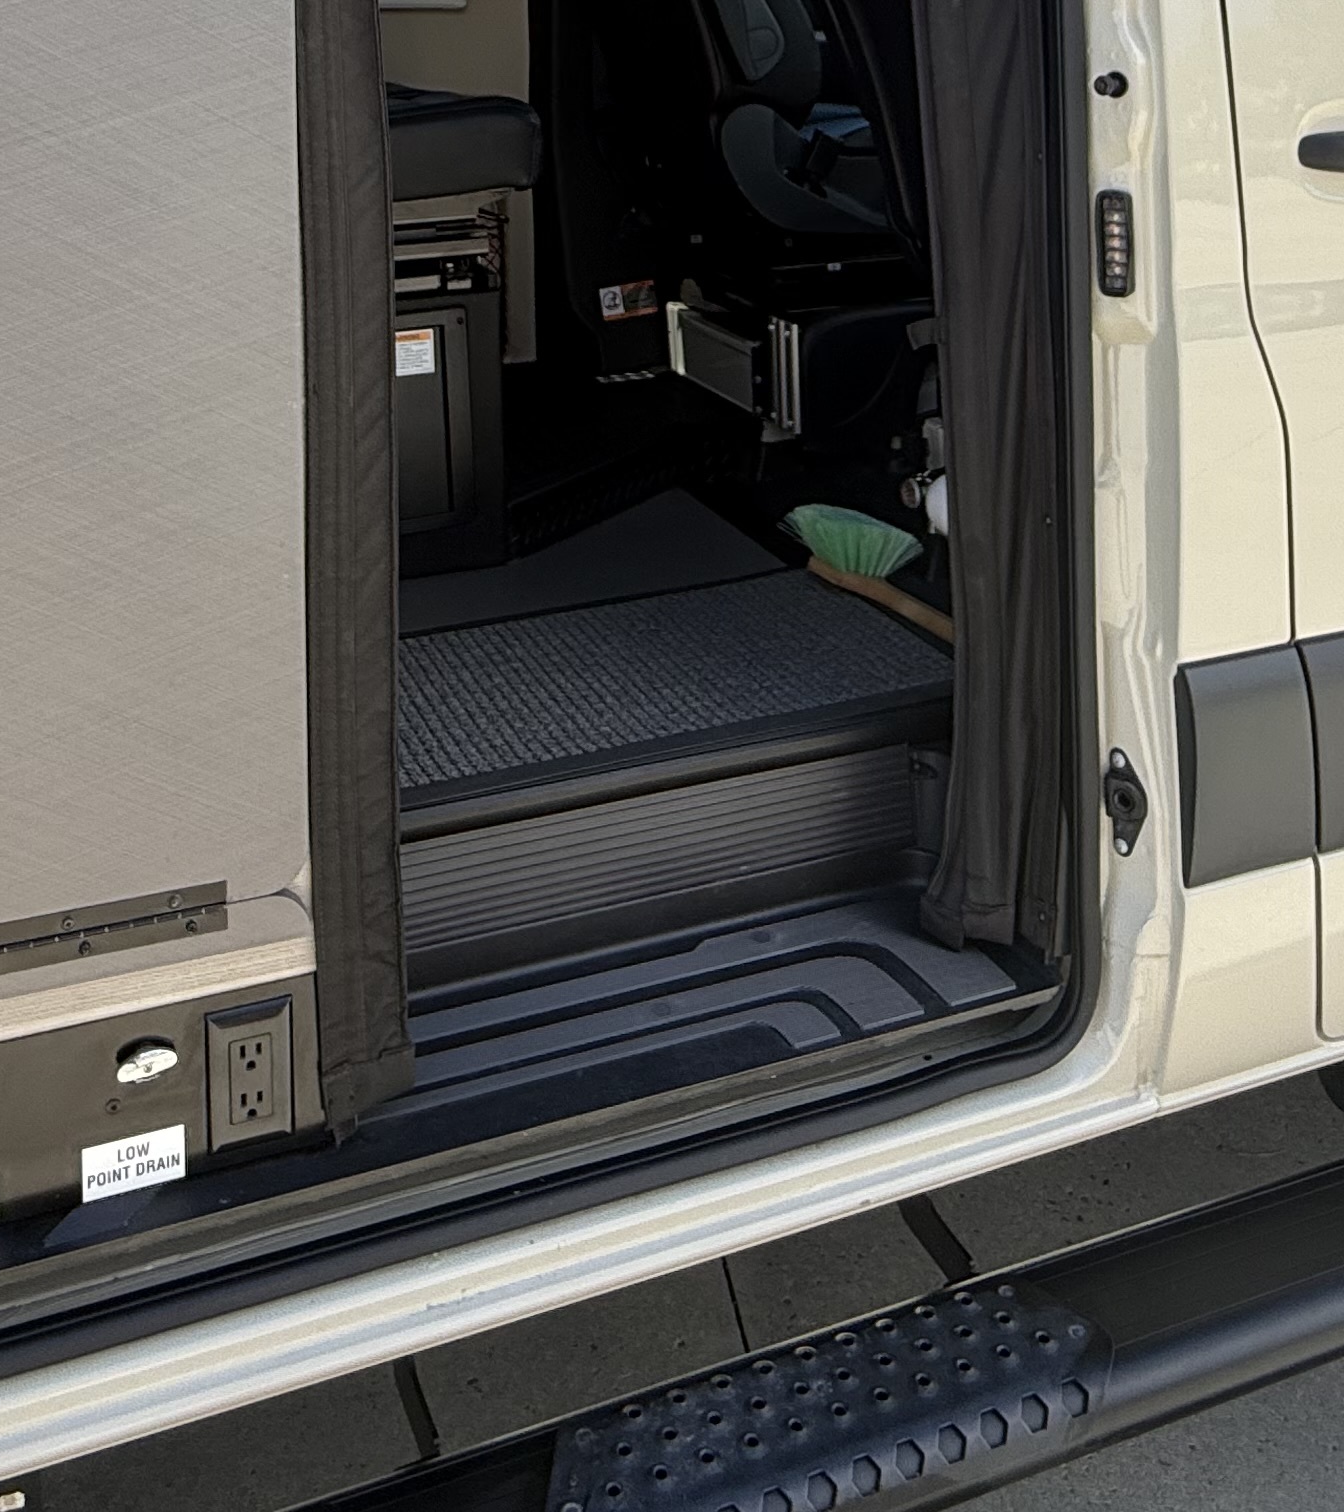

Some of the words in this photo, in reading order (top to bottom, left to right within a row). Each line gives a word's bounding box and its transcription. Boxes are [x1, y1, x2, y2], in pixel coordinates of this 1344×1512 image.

[118, 1141, 150, 1163] LOW
[87, 1165, 131, 1190] POINT
[136, 1152, 180, 1177] DRAIN
